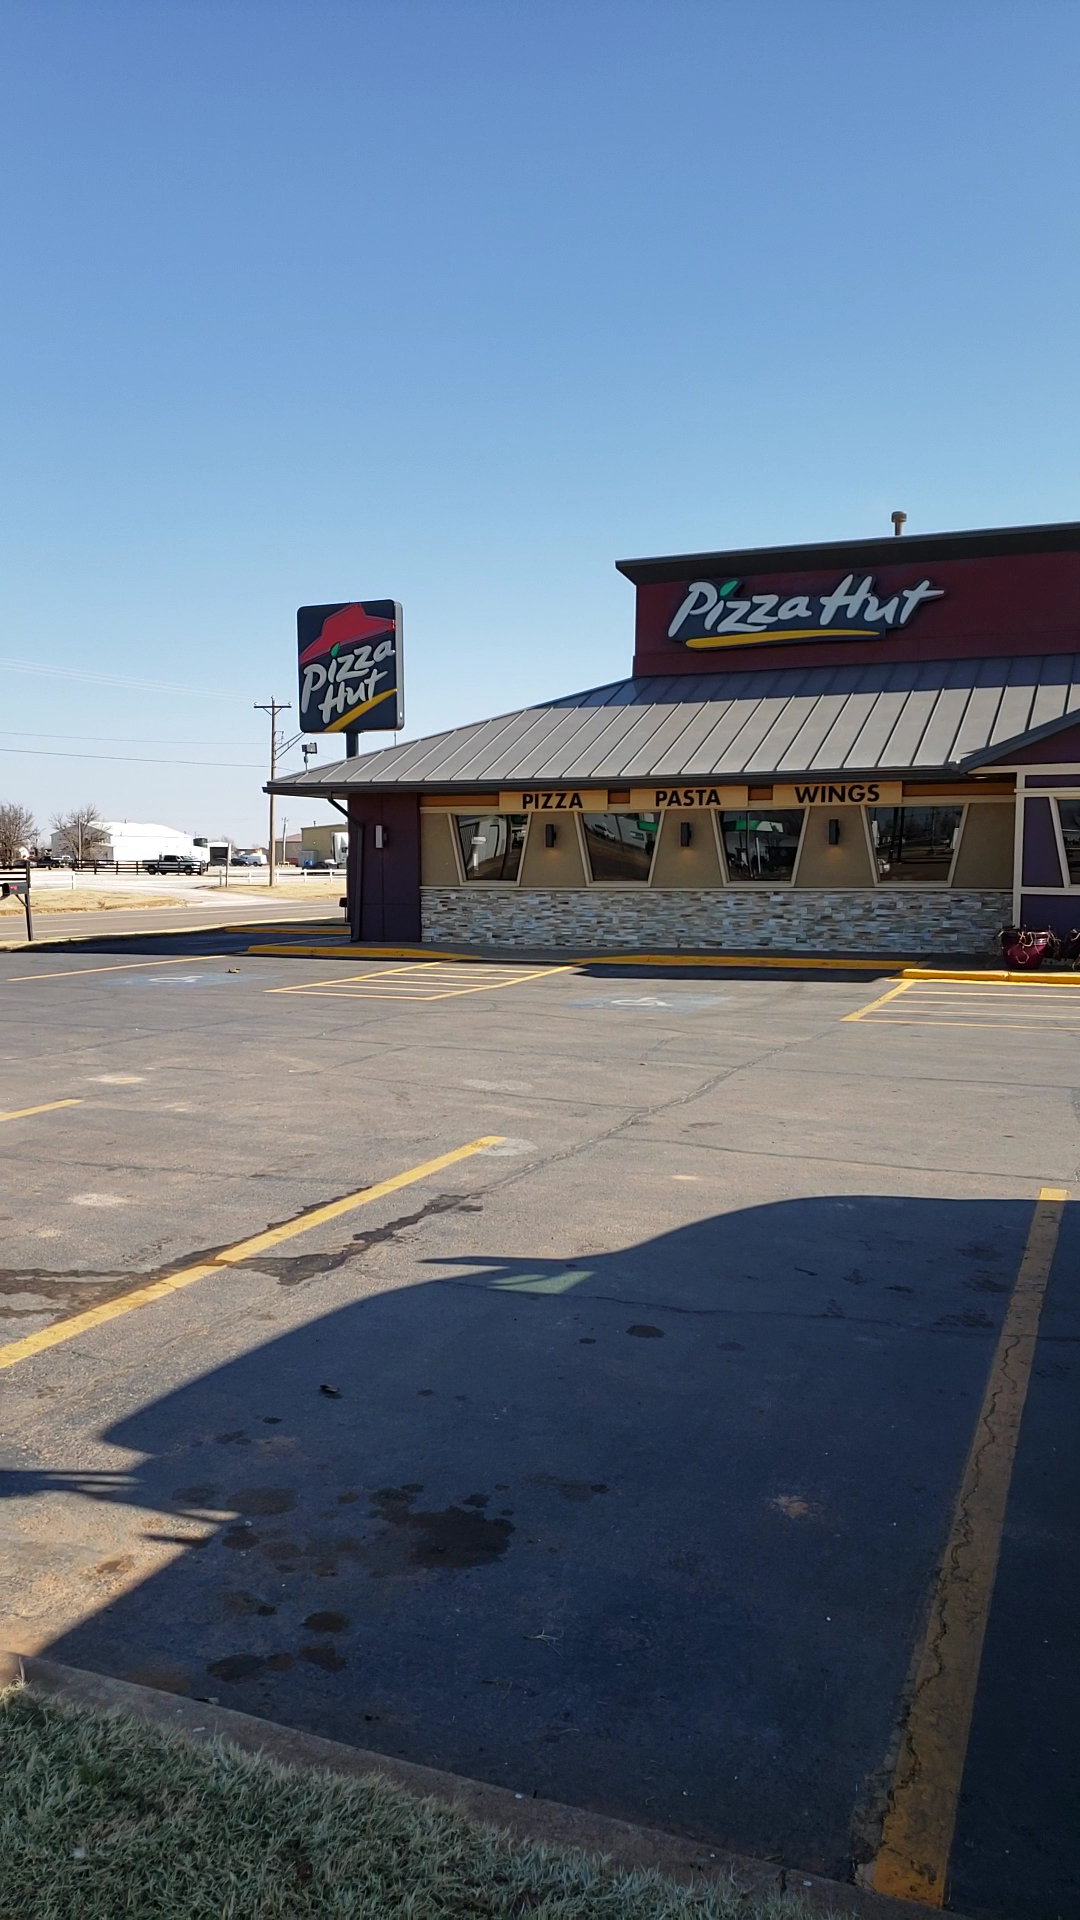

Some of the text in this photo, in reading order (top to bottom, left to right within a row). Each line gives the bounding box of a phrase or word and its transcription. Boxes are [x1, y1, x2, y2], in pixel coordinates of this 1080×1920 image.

[667, 574, 945, 637] Pizza Hut
[301, 640, 395, 713] Pizza
[318, 668, 388, 724] Hut
[522, 792, 583, 809] PIZZA
[655, 789, 721, 807] PASTA
[795, 784, 880, 803] WINGS
